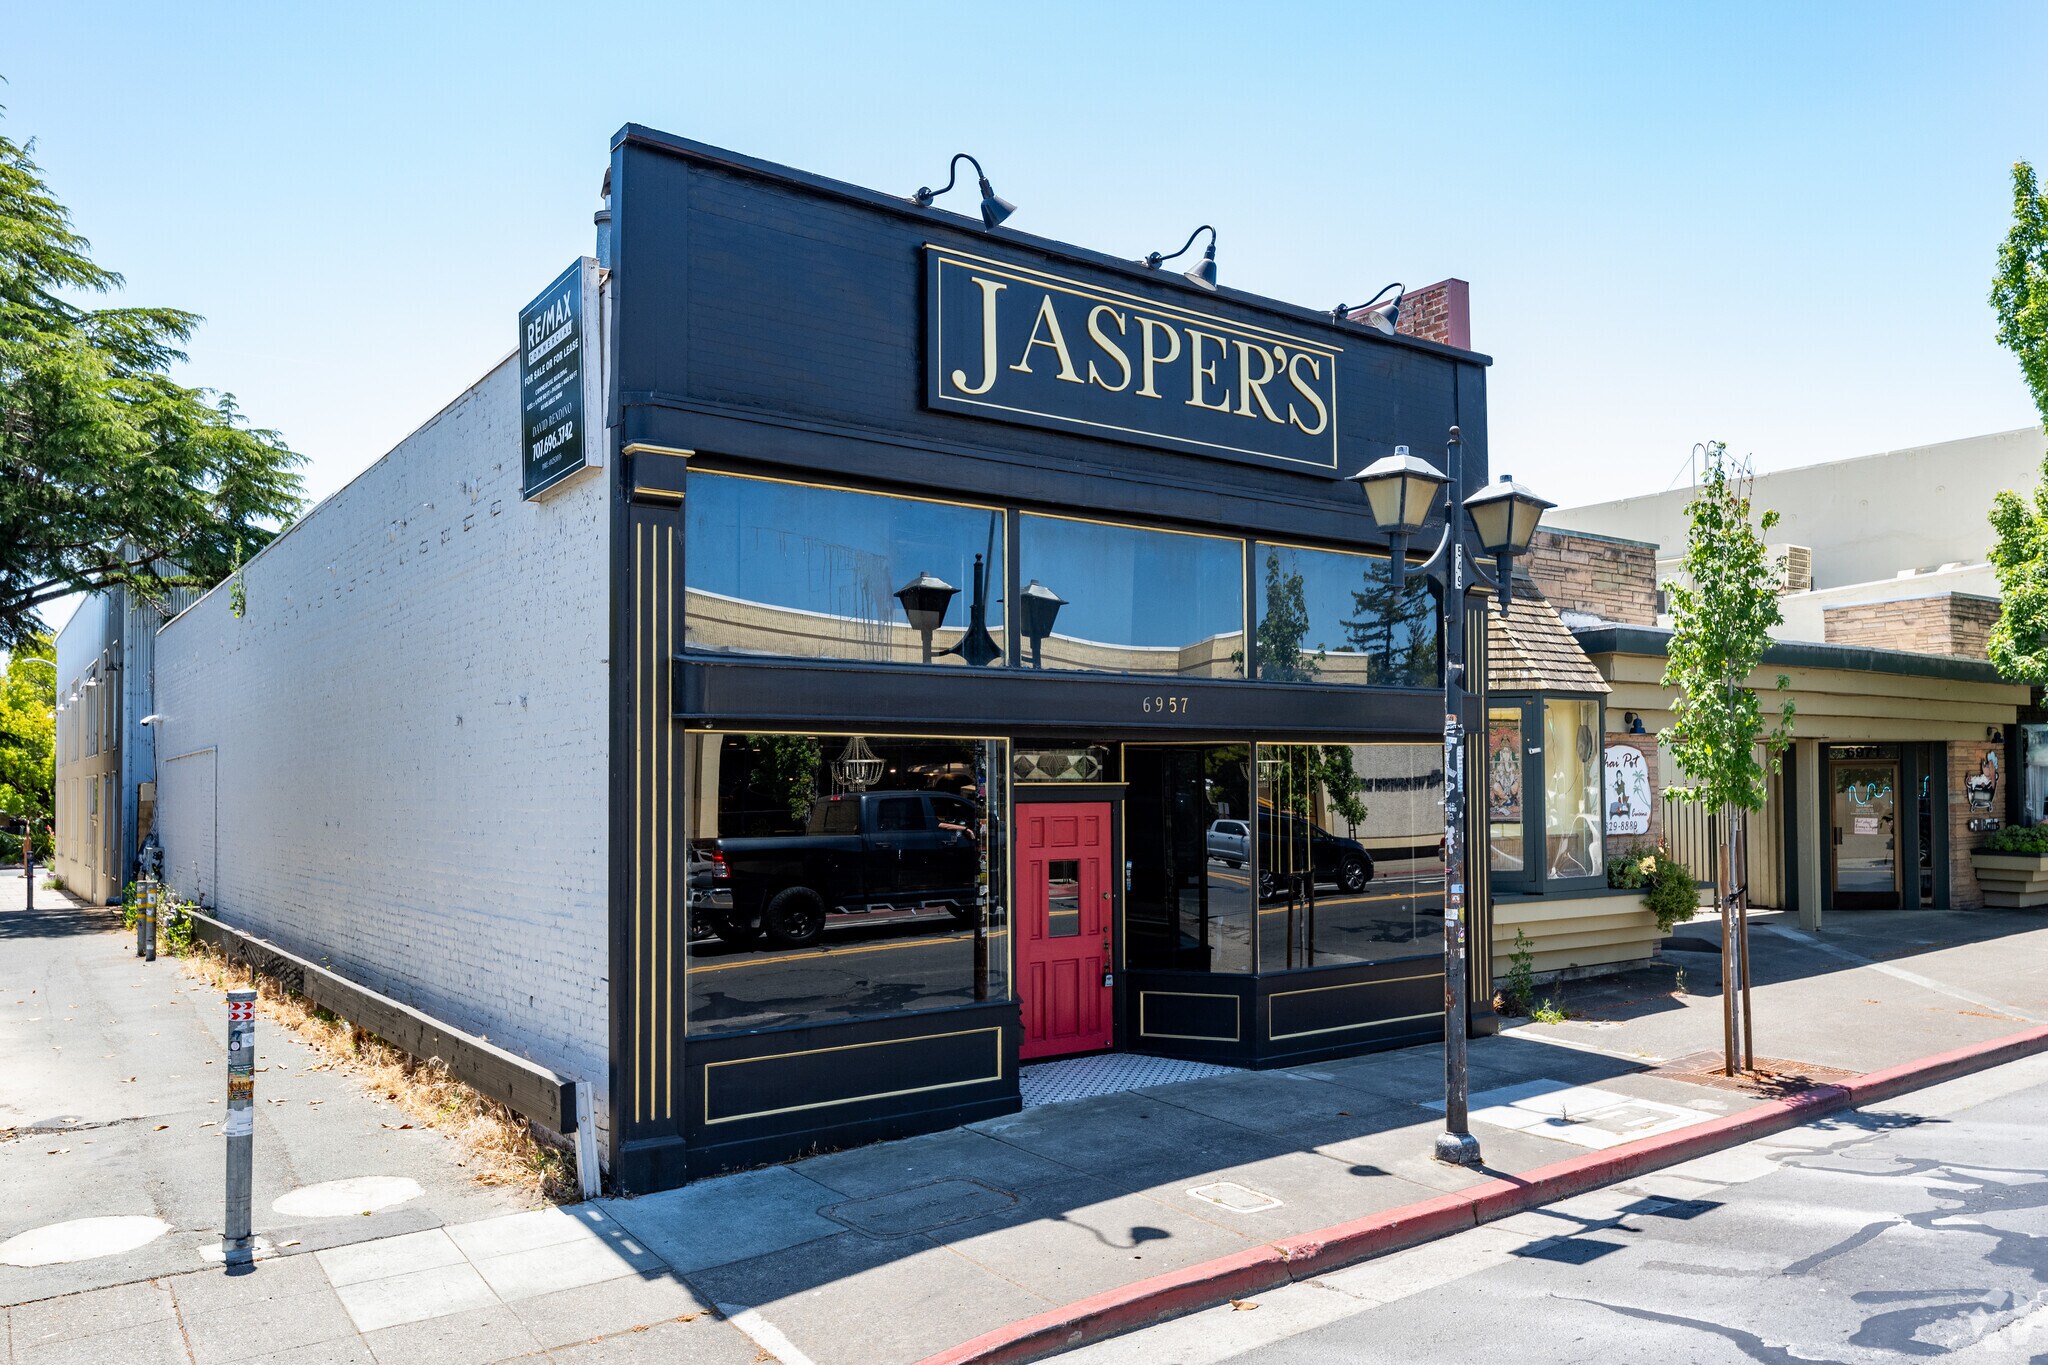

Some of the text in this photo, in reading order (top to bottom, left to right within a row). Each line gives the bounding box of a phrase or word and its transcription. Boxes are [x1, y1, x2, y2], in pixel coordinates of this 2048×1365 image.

[528, 290, 571, 350] RE/MAX
[524, 338, 579, 387] FOR SALE OR FOR LEASE
[529, 325, 571, 364] COMMERCIAL
[951, 276, 1328, 436] JASPER'S
[532, 402, 572, 438] DAVID RENDINO
[532, 421, 573, 462] 707.696.3742
[1142, 696, 1189, 713] 6957
[1605, 752, 1620, 768] hai
[1847, 745, 1880, 758] 6971
